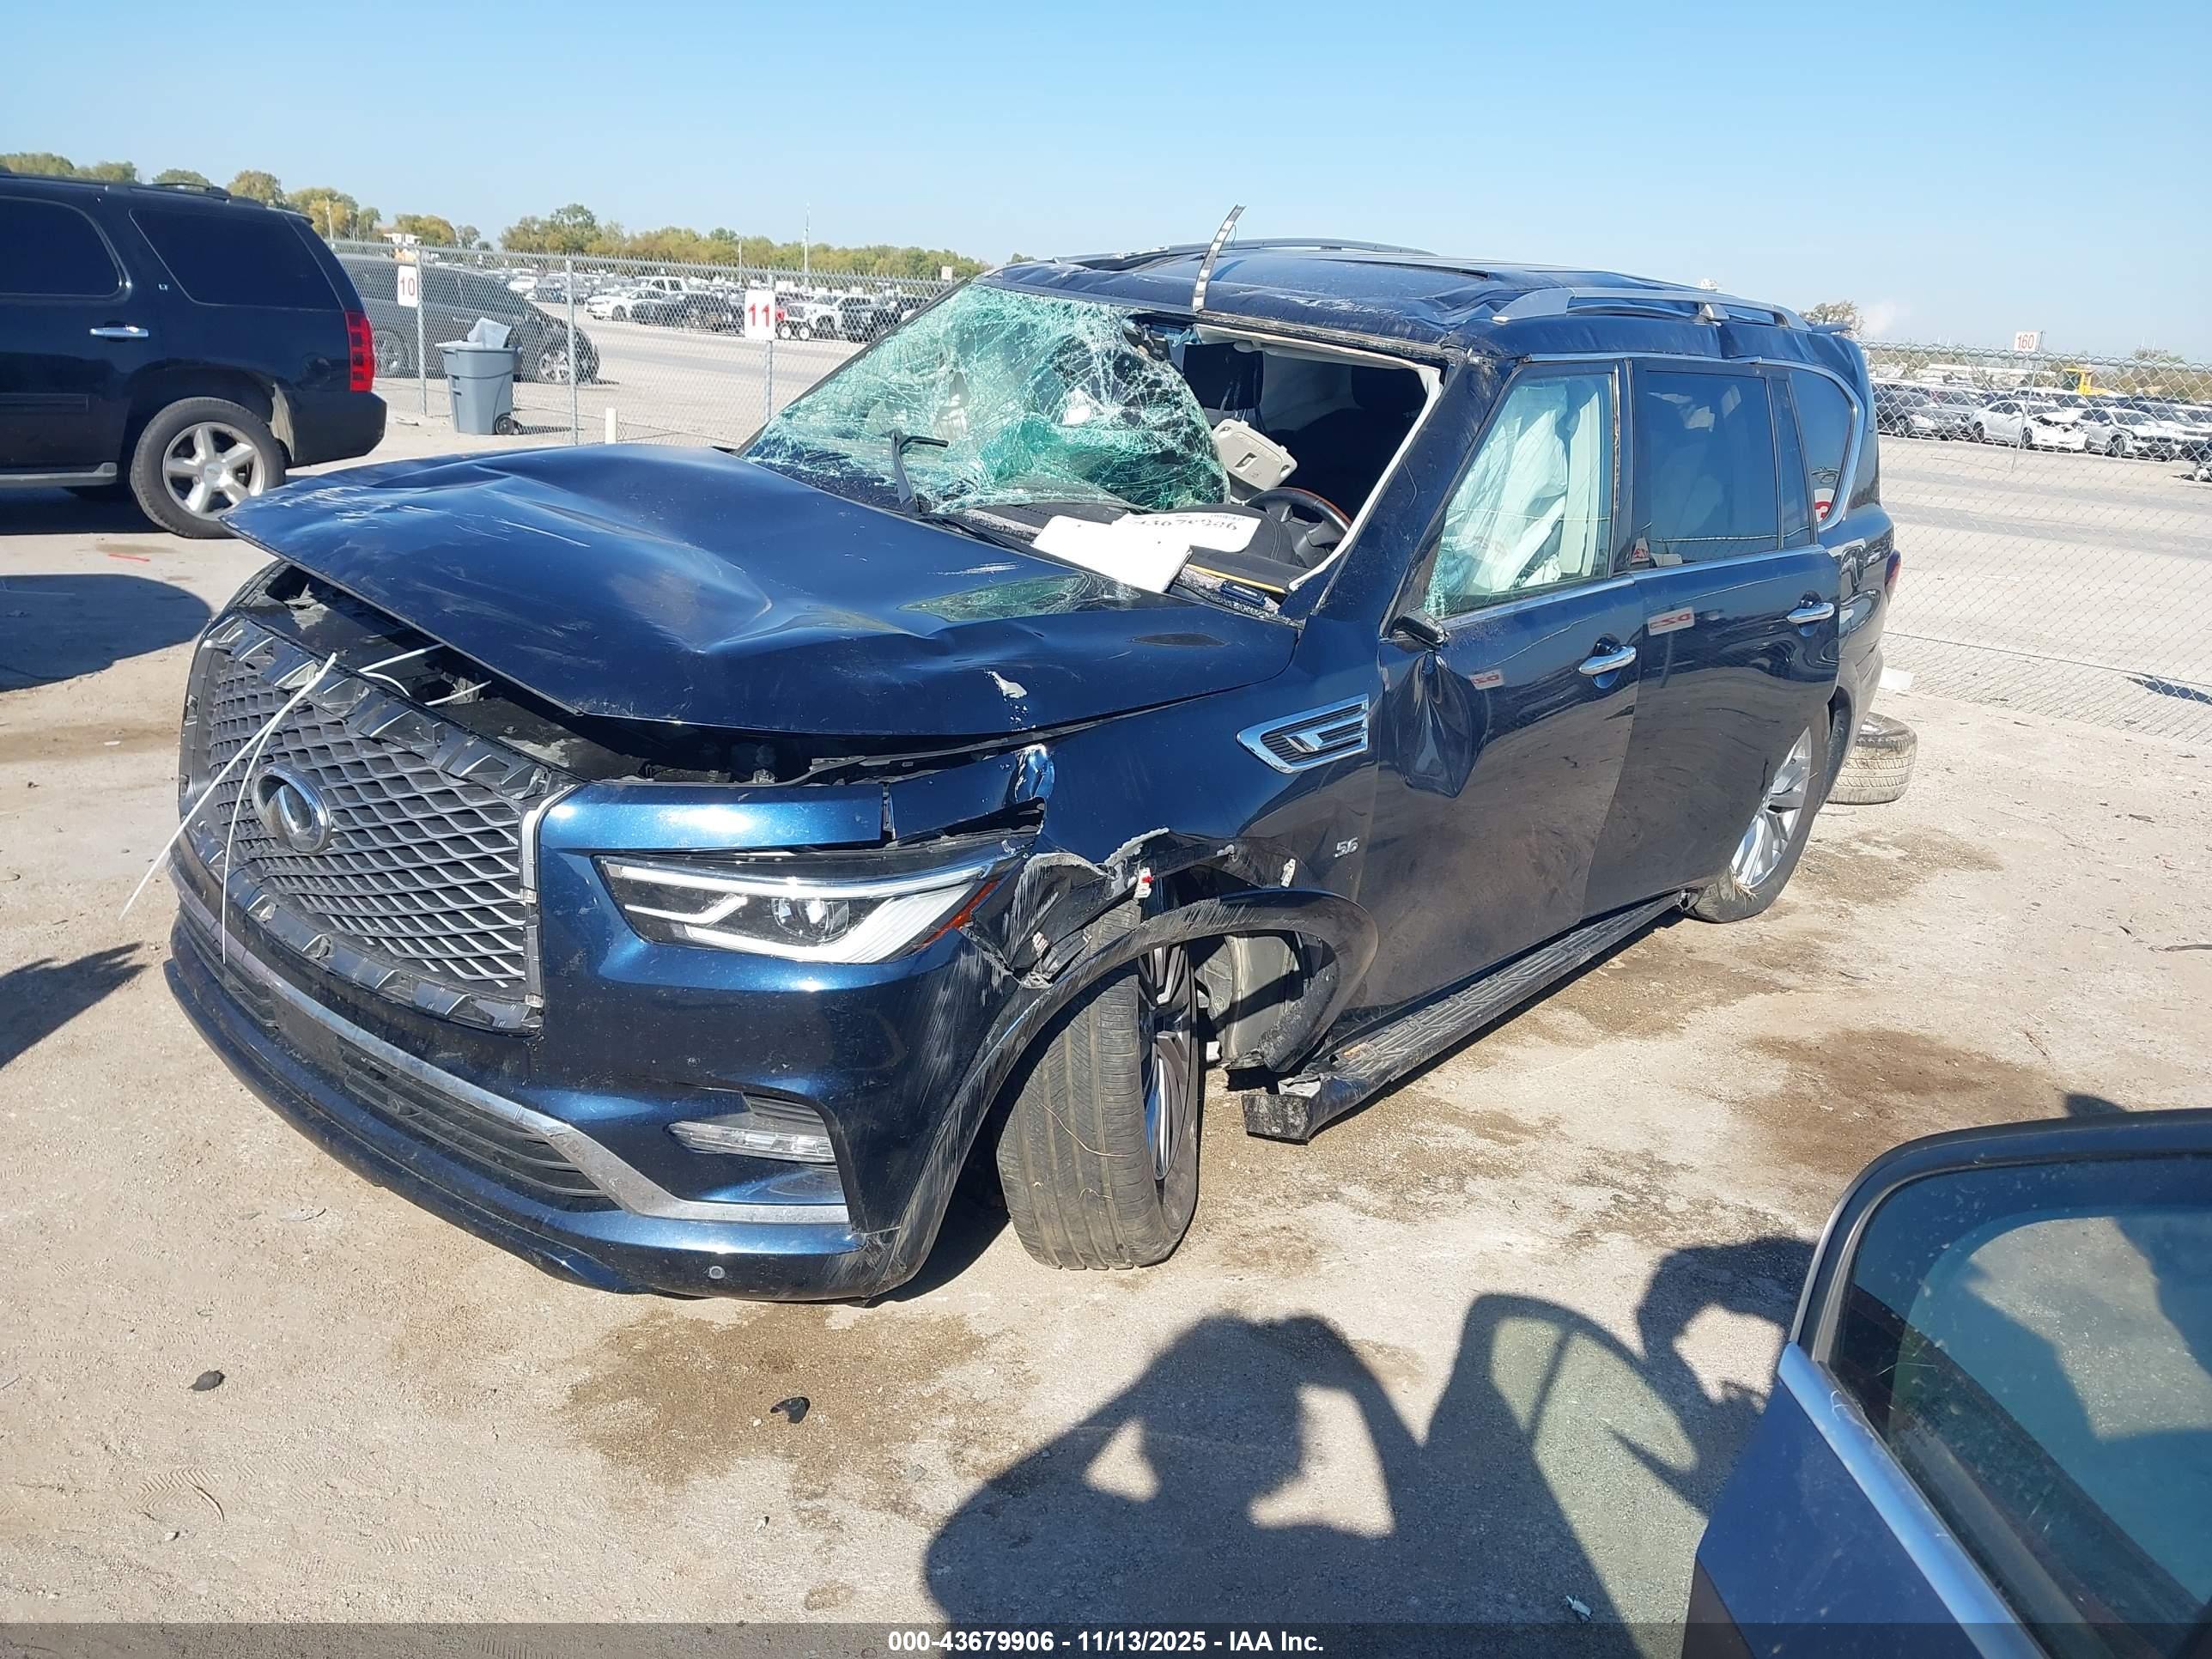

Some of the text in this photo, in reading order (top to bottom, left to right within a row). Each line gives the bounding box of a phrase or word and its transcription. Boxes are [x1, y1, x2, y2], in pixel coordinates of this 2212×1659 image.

[399, 276, 416, 296] 10
[748, 302, 770, 328] 11
[2017, 334, 2035, 349] 160
